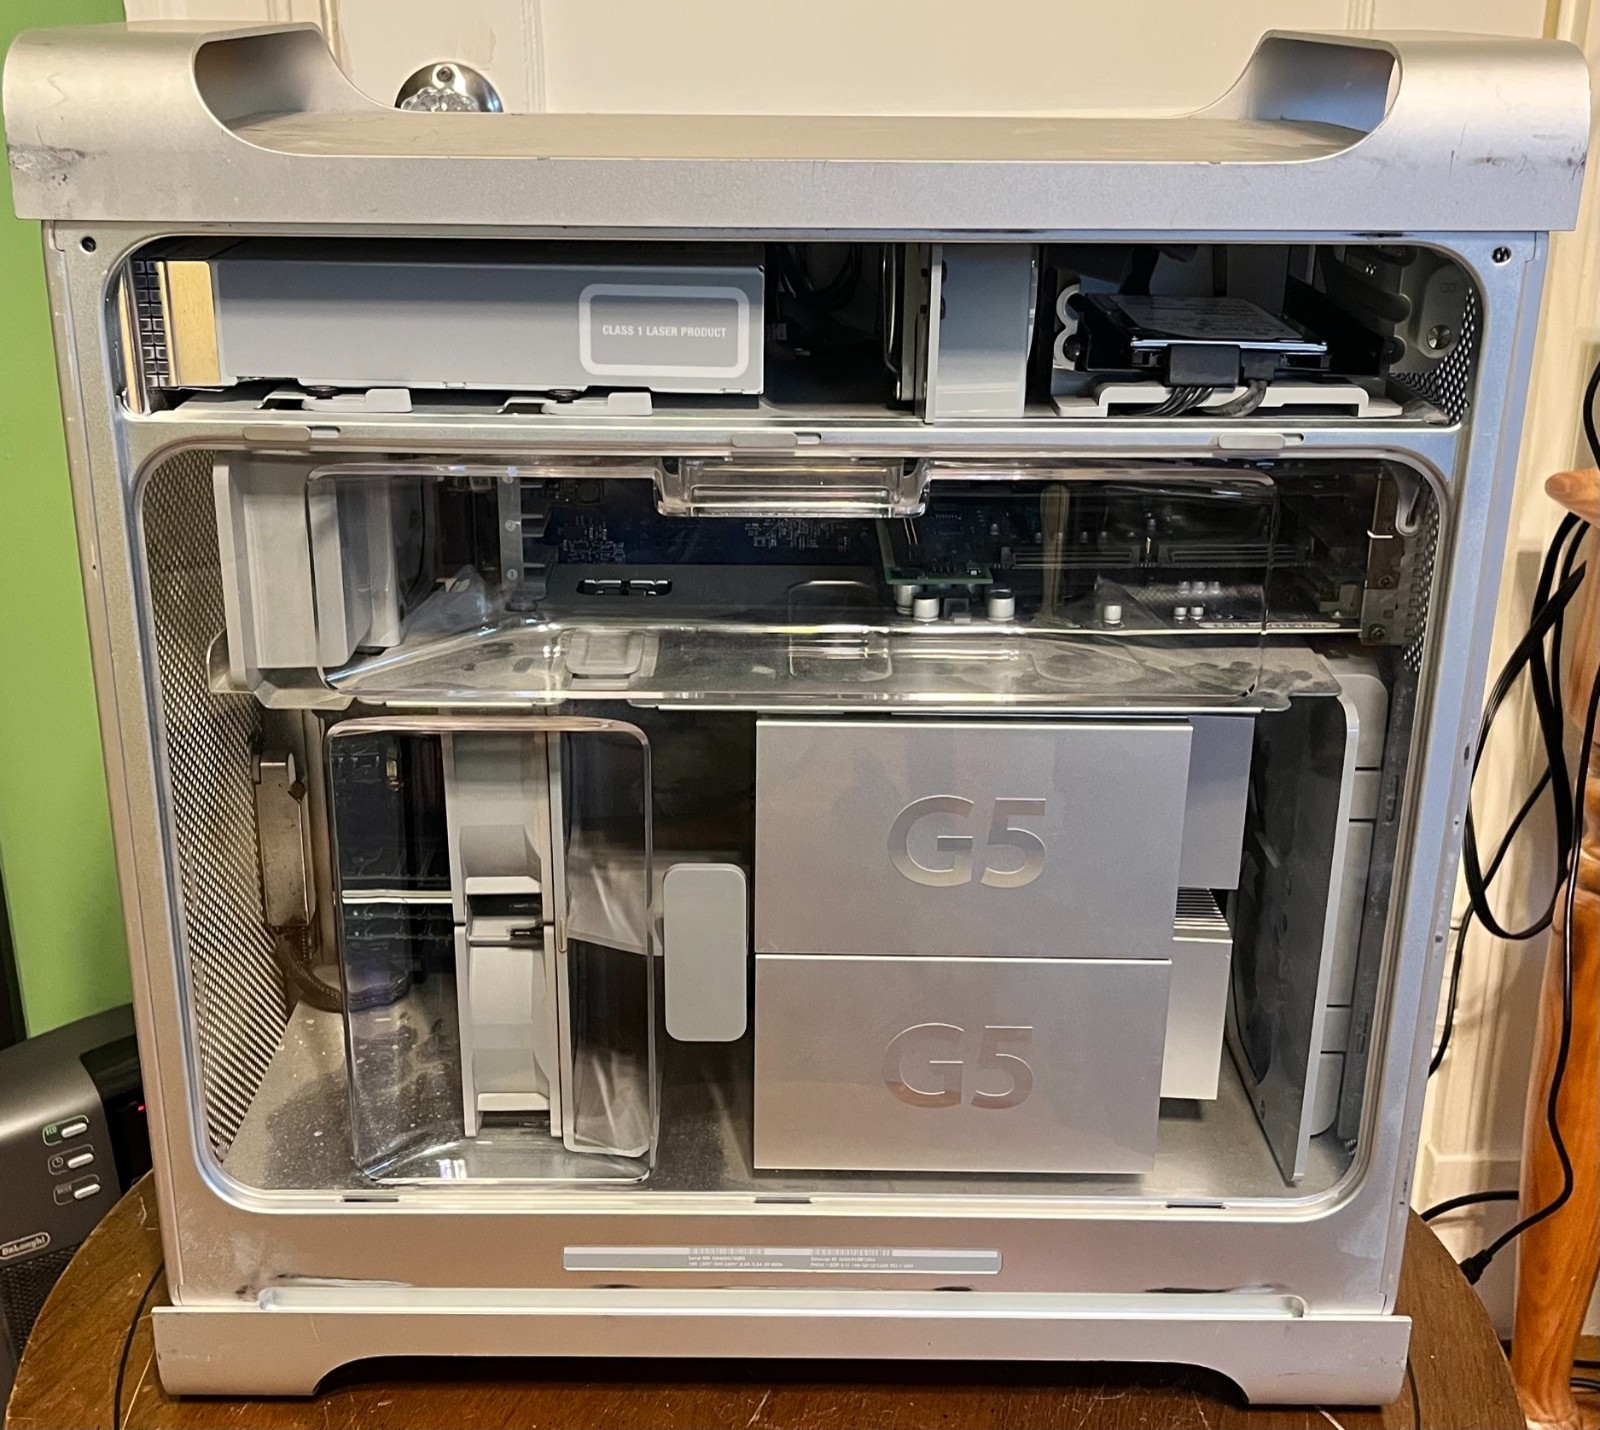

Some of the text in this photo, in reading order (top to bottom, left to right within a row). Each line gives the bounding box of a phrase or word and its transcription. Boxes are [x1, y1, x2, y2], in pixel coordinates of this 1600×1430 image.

[603, 325, 727, 338] CLASS 1 LASER PRODUCT
[887, 794, 1046, 889] G5
[881, 1022, 1033, 1110] G5
